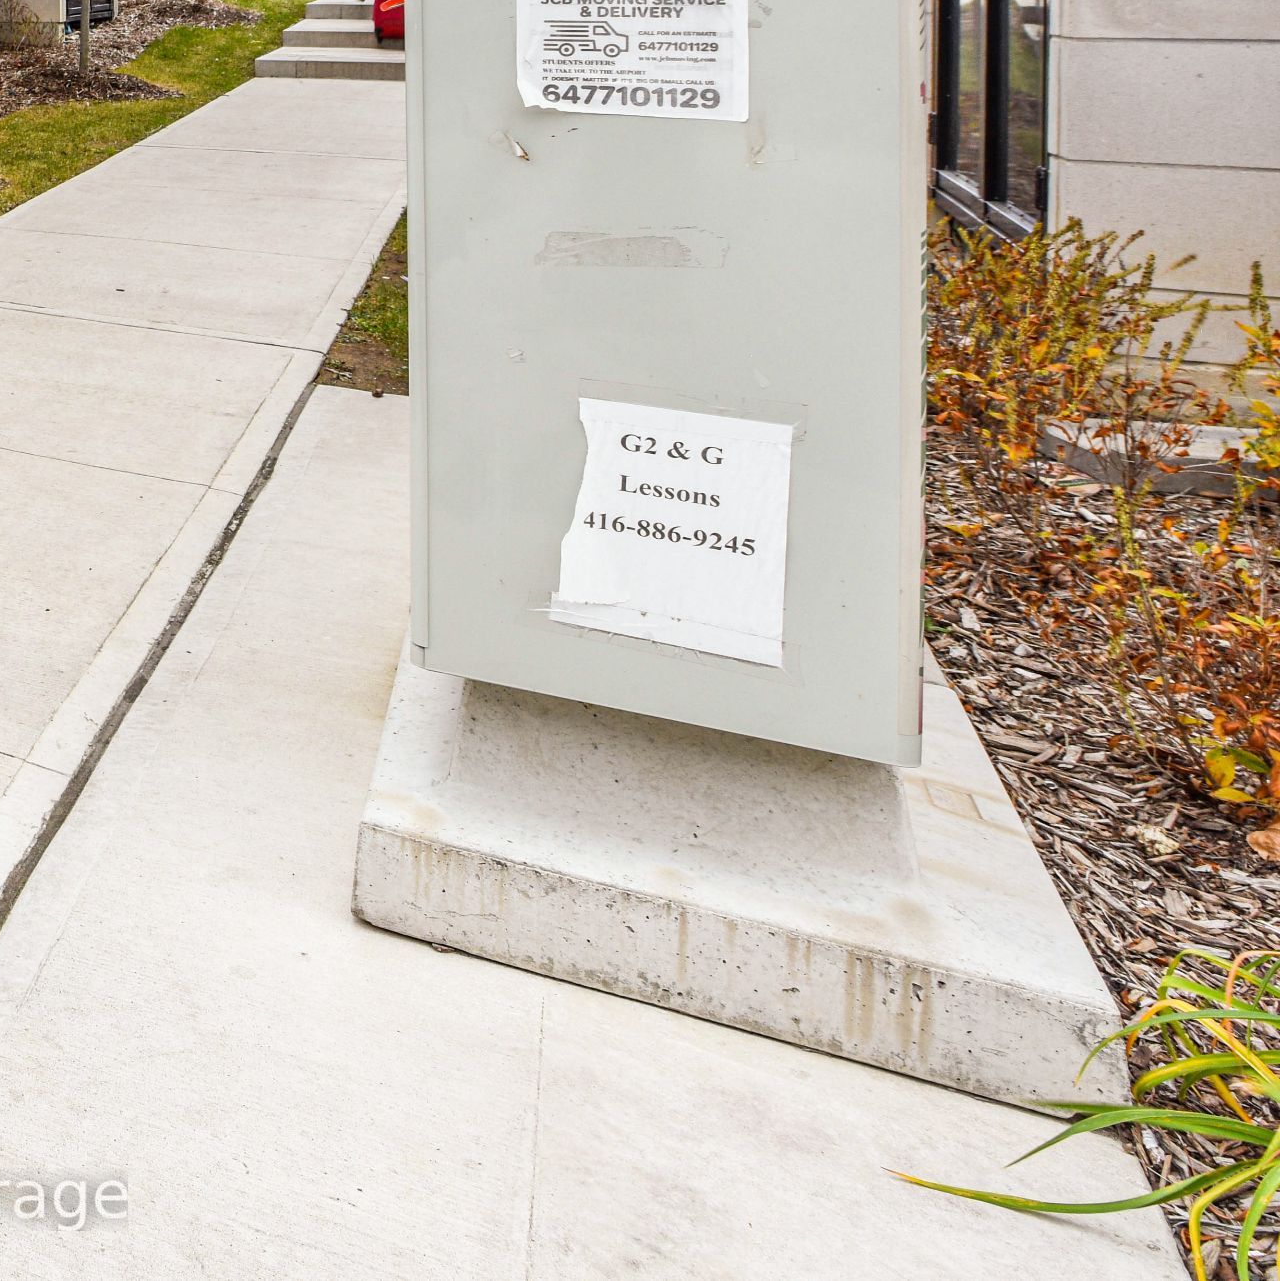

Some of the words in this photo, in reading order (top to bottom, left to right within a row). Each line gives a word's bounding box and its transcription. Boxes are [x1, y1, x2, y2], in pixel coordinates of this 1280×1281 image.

[580, 7, 591, 17] &
[597, 7, 683, 18] DELIVERY
[638, 42, 718, 51] 6477101129
[542, 84, 720, 109] 6477101129
[621, 434, 656, 454] G2
[668, 442, 689, 460] &
[702, 447, 722, 464] G
[620, 475, 720, 507] Lessons
[584, 512, 755, 555] 416-886-9245
